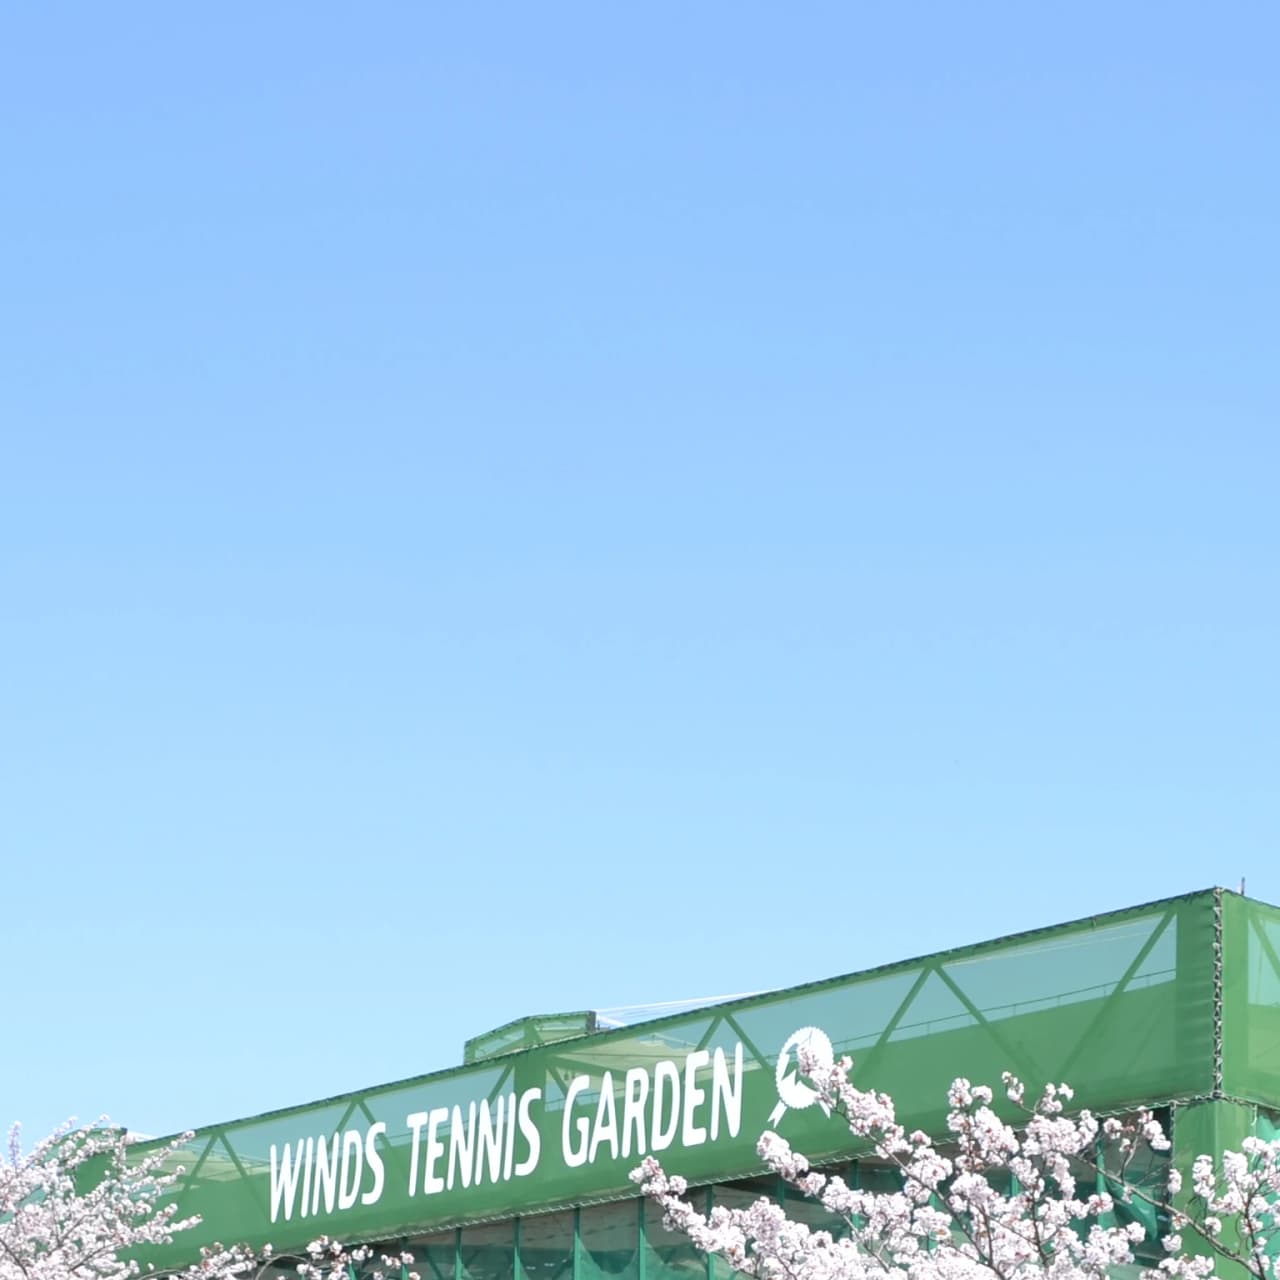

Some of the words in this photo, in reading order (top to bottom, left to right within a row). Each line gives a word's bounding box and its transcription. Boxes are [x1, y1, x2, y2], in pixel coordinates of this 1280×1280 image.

[269, 1122, 386, 1223] WINDS
[406, 1087, 542, 1197] TENNIS
[562, 1041, 744, 1168] GARDEN
